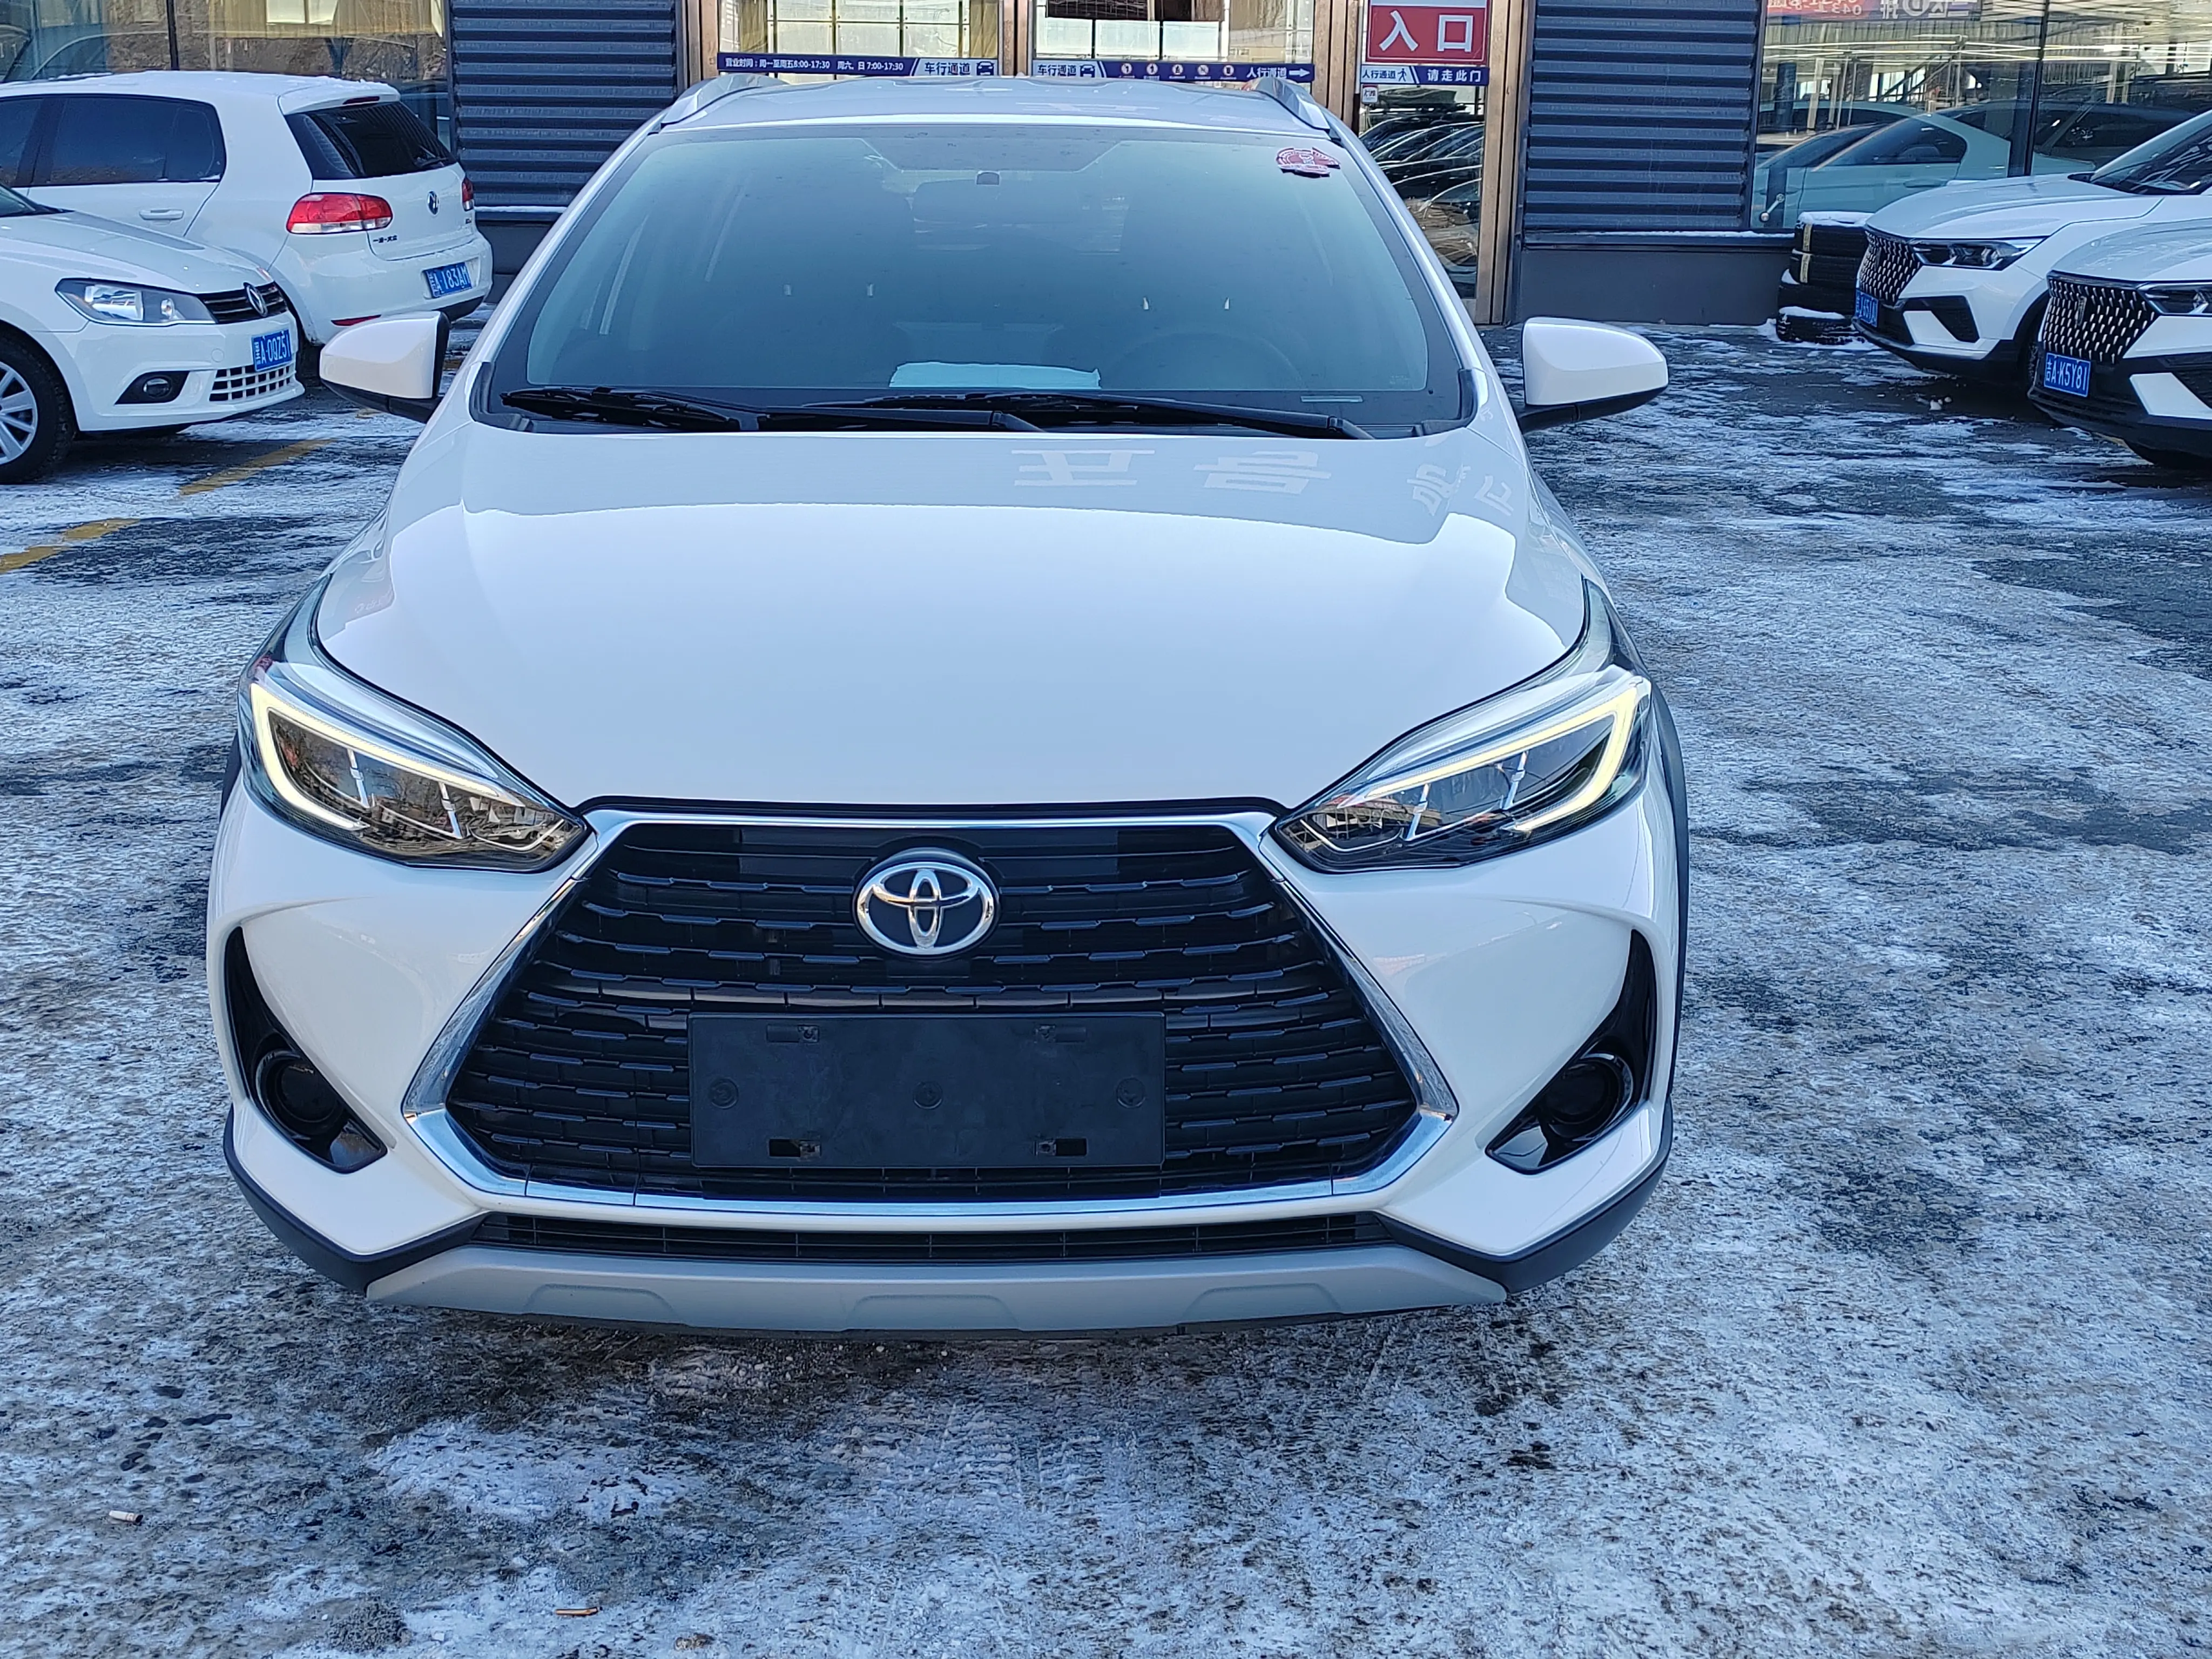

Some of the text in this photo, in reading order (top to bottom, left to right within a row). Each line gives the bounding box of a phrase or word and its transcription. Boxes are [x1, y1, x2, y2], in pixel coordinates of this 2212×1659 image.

[1379, 10, 1474, 52] 入口
[925, 62, 971, 76] 车行通道
[1037, 65, 1077, 76] 车行通道
[1362, 69, 1396, 79] 人行通道
[1427, 69, 1482, 83] 请走此门
